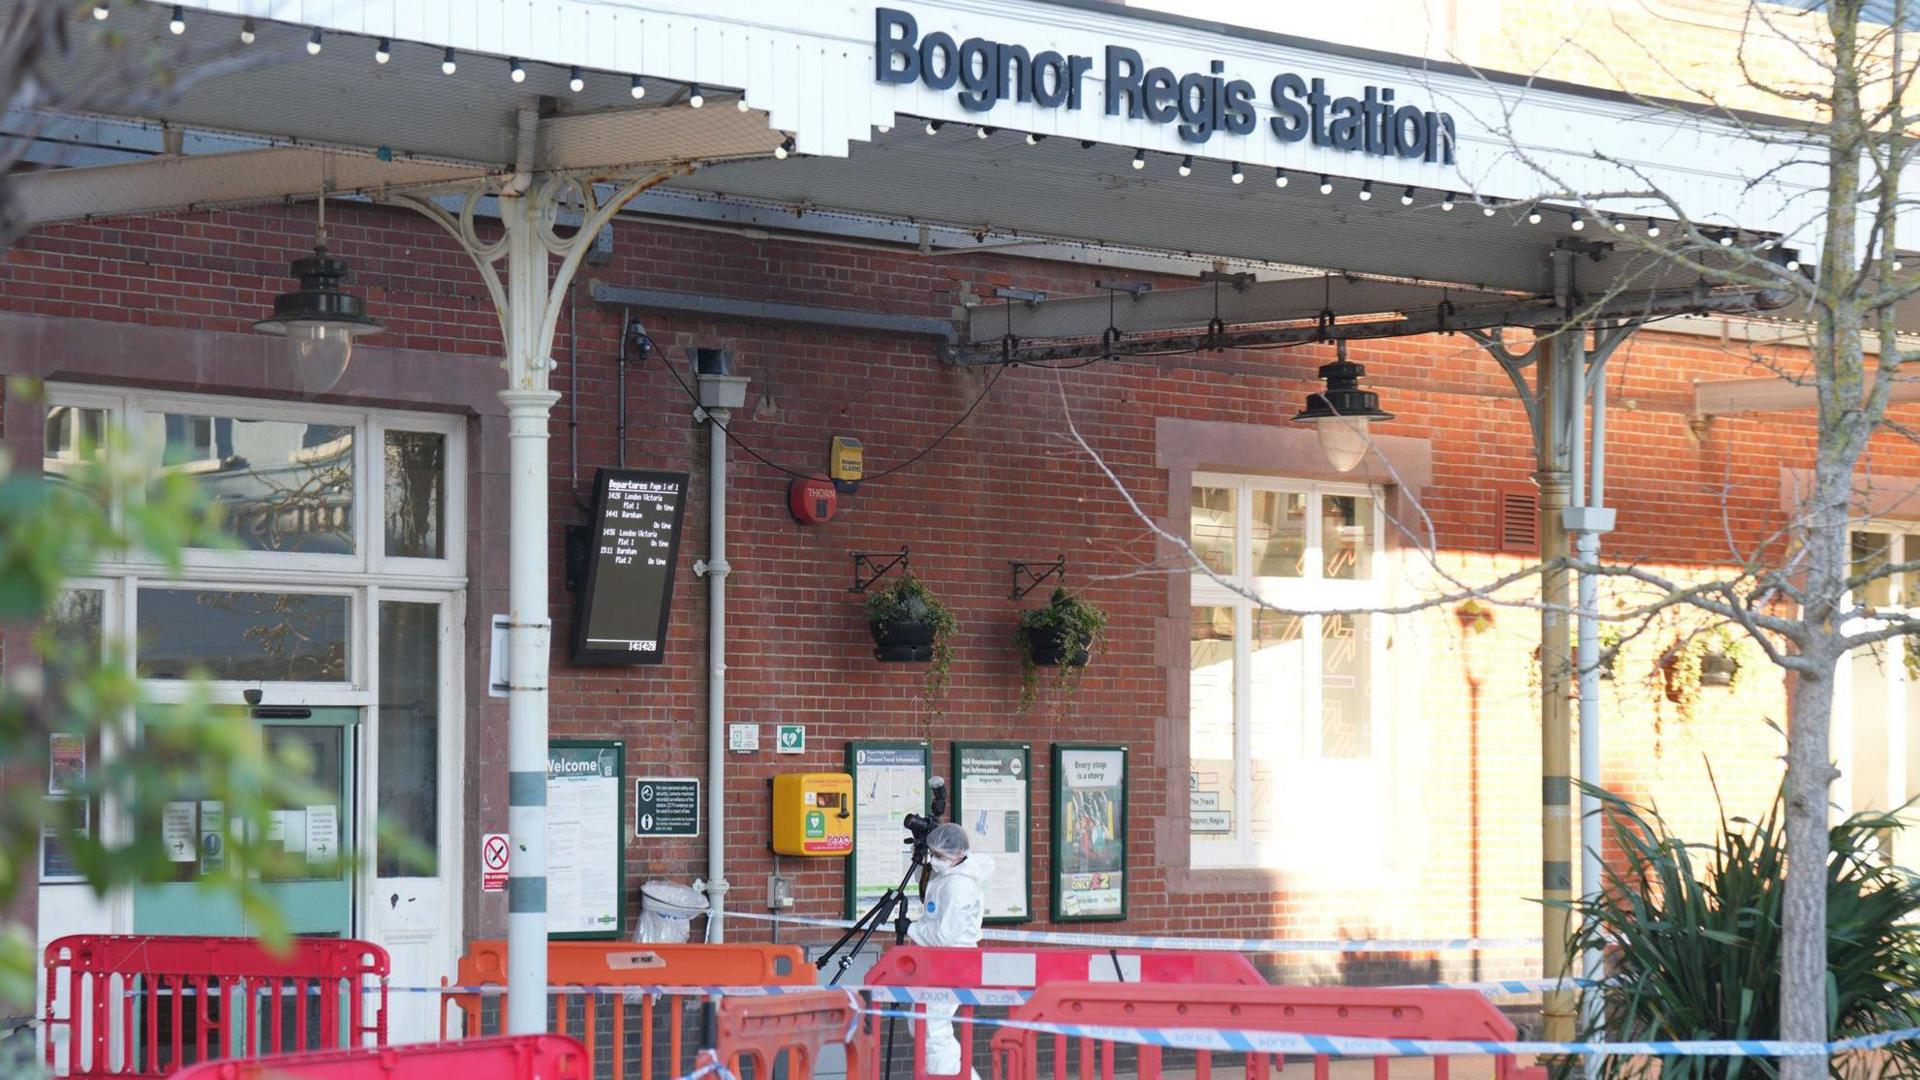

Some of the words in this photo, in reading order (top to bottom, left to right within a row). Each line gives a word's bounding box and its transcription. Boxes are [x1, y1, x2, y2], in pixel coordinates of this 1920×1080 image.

[875, 7, 1092, 112] Bognor
[1105, 44, 1256, 144] Regis
[1270, 72, 1455, 165] Station
[608, 479, 648, 490] Departures
[649, 482, 661, 491] Page
[624, 492, 642, 500] London
[643, 493, 663, 502] Victoria
[807, 488, 836, 498] THORN
[656, 503, 663, 511] On
[664, 504, 674, 512] time
[653, 521, 660, 529] On
[661, 521, 672, 530] time
[619, 529, 636, 537] London
[638, 529, 658, 538] Victoria
[658, 540, 669, 548] time
[628, 556, 632, 564] 2
[648, 557, 655, 565] On
[656, 558, 666, 566] time
[1074, 761, 1091, 771] Every
[1092, 761, 1107, 771] stop
[1077, 771, 1082, 779] is
[1088, 772, 1104, 781] story
